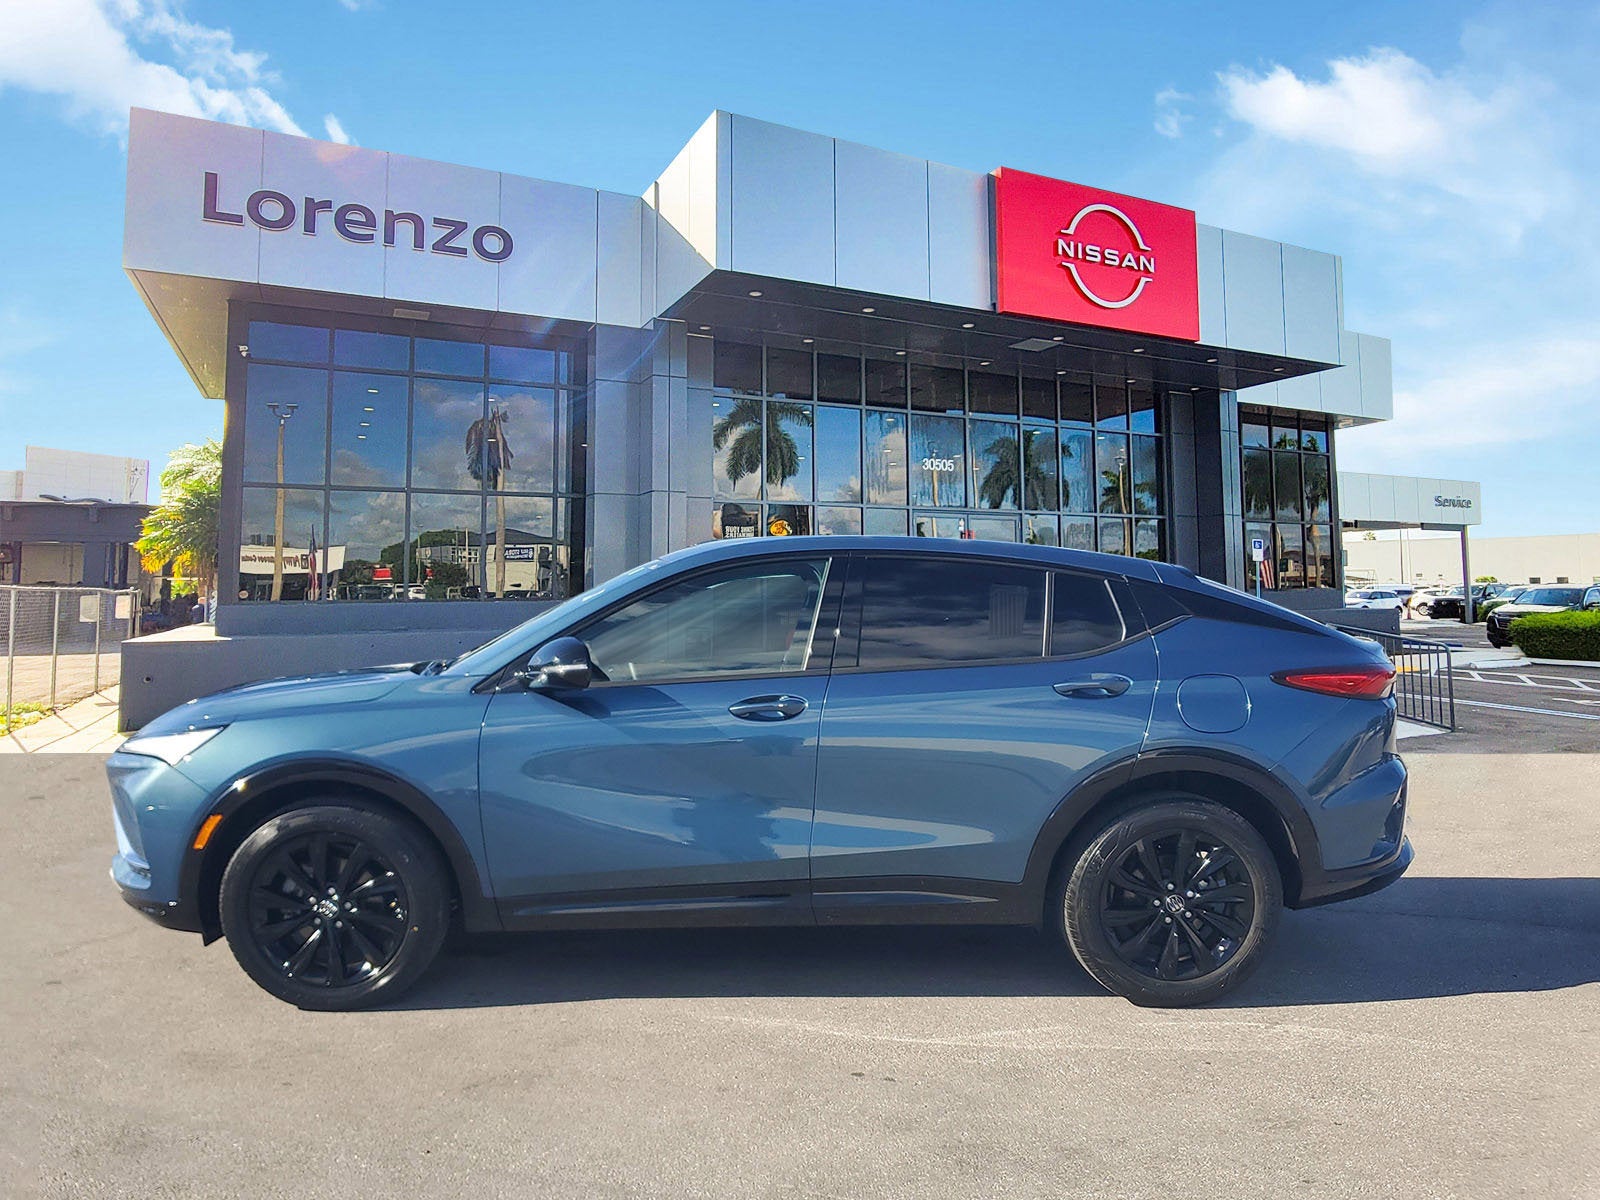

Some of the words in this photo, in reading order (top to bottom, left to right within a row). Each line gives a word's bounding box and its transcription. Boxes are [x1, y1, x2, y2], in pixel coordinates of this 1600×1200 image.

[202, 171, 514, 262] Lorenzo
[1057, 238, 1155, 273] NISSAN
[922, 458, 954, 471] 30505
[1434, 495, 1472, 508] Service
